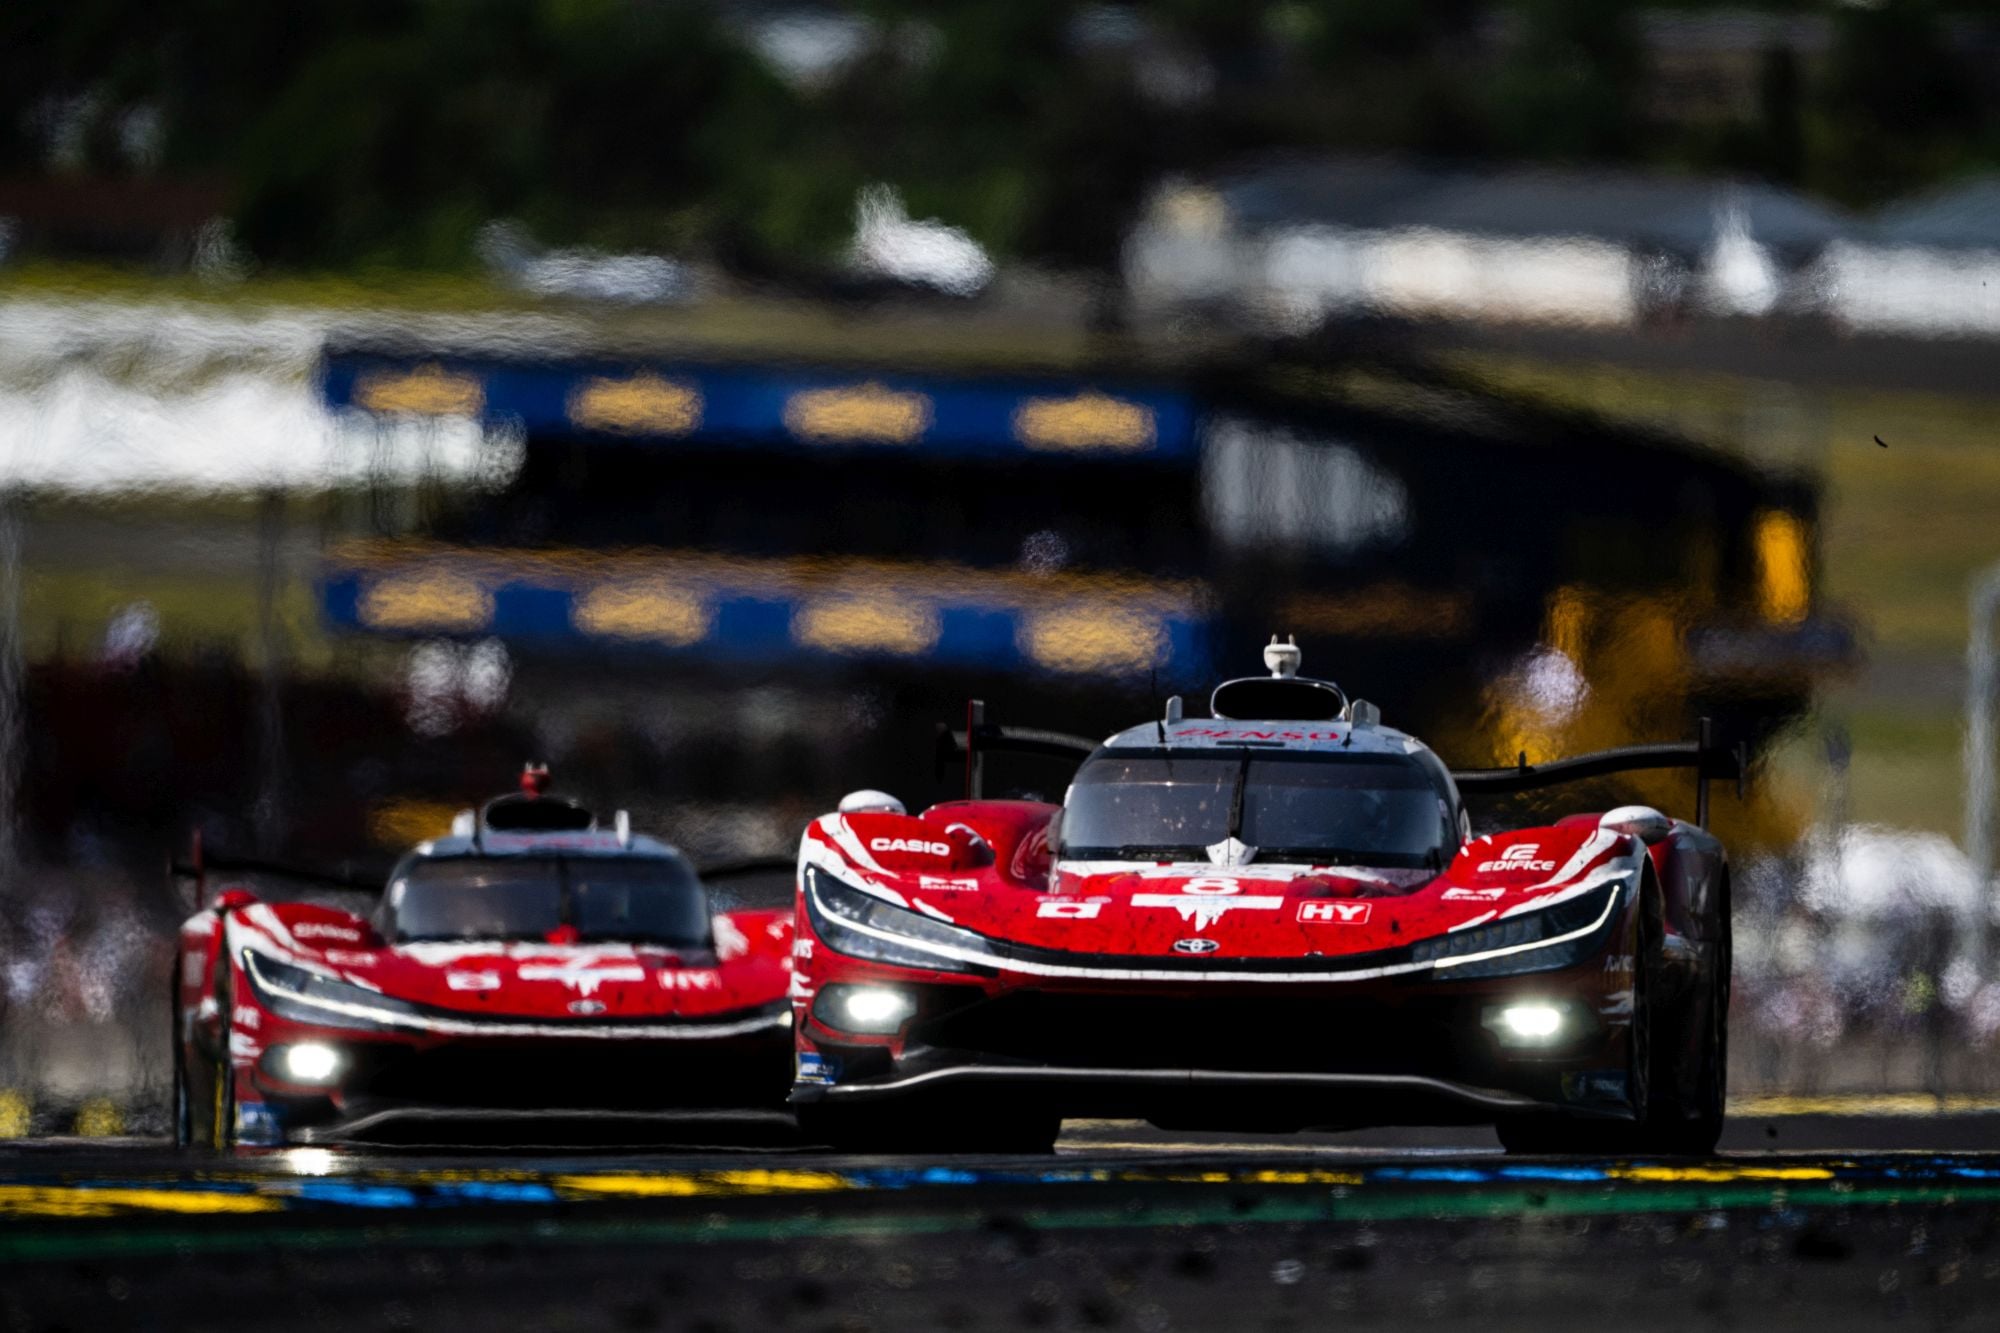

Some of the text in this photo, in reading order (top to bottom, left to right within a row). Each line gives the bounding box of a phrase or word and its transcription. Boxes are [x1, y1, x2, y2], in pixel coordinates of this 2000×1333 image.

[1174, 729, 1339, 741] DENSO
[870, 838, 950, 856] CASIO
[1477, 860, 1555, 872] EDIFICE
[1182, 878, 1240, 895] 8
[1302, 904, 1366, 920] HY
